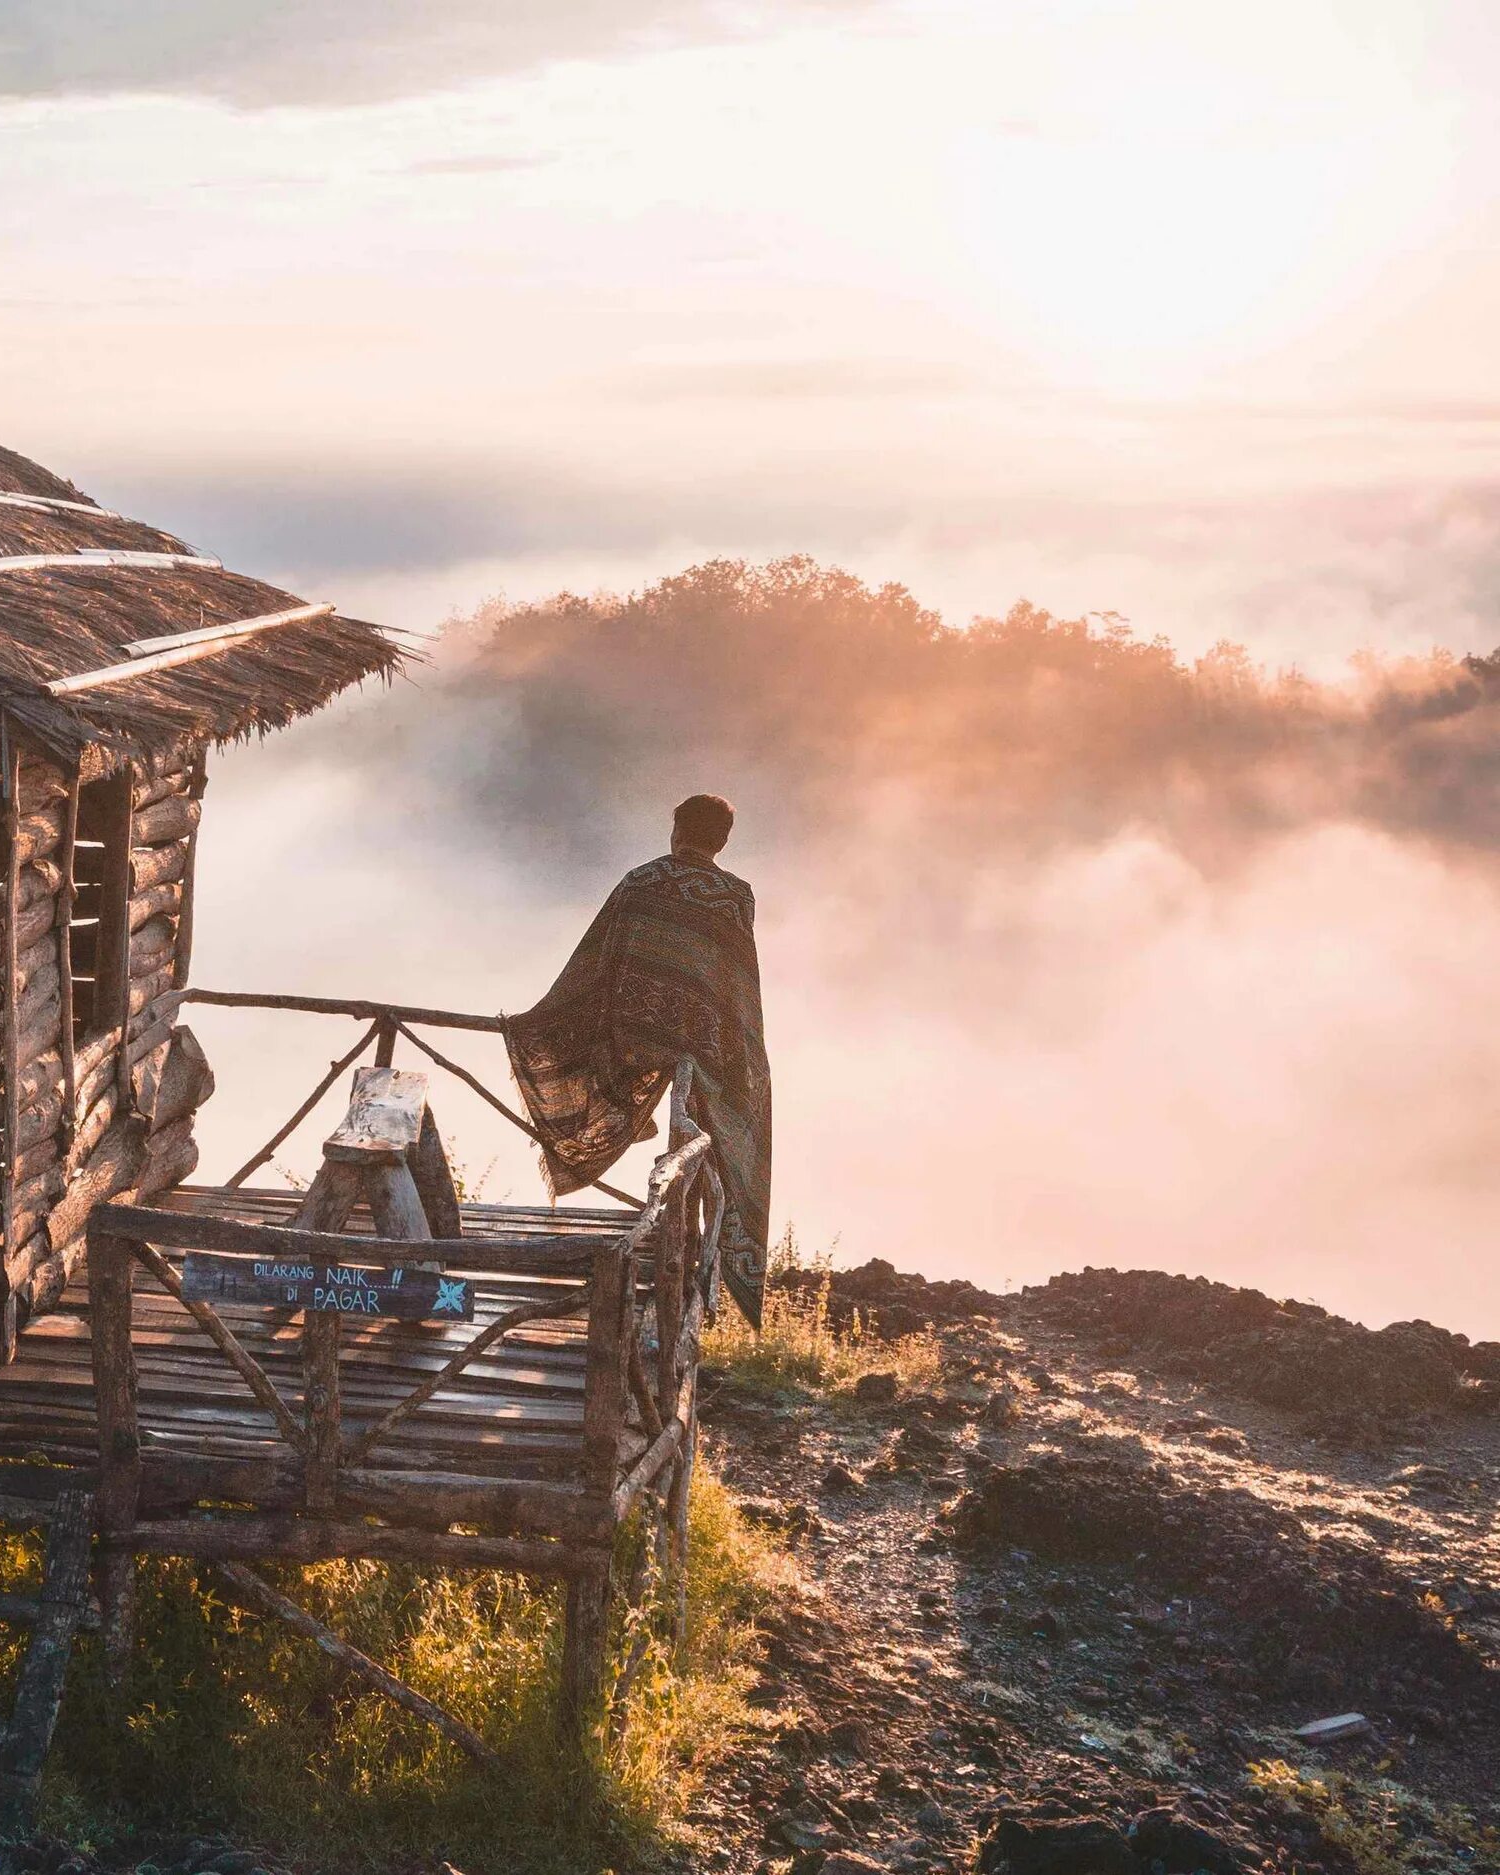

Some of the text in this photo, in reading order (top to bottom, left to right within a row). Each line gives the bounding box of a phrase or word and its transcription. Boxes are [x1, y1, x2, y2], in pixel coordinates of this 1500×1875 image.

[254, 1263, 315, 1280] DILARANG
[287, 1288, 380, 1313] DI PAGAR
